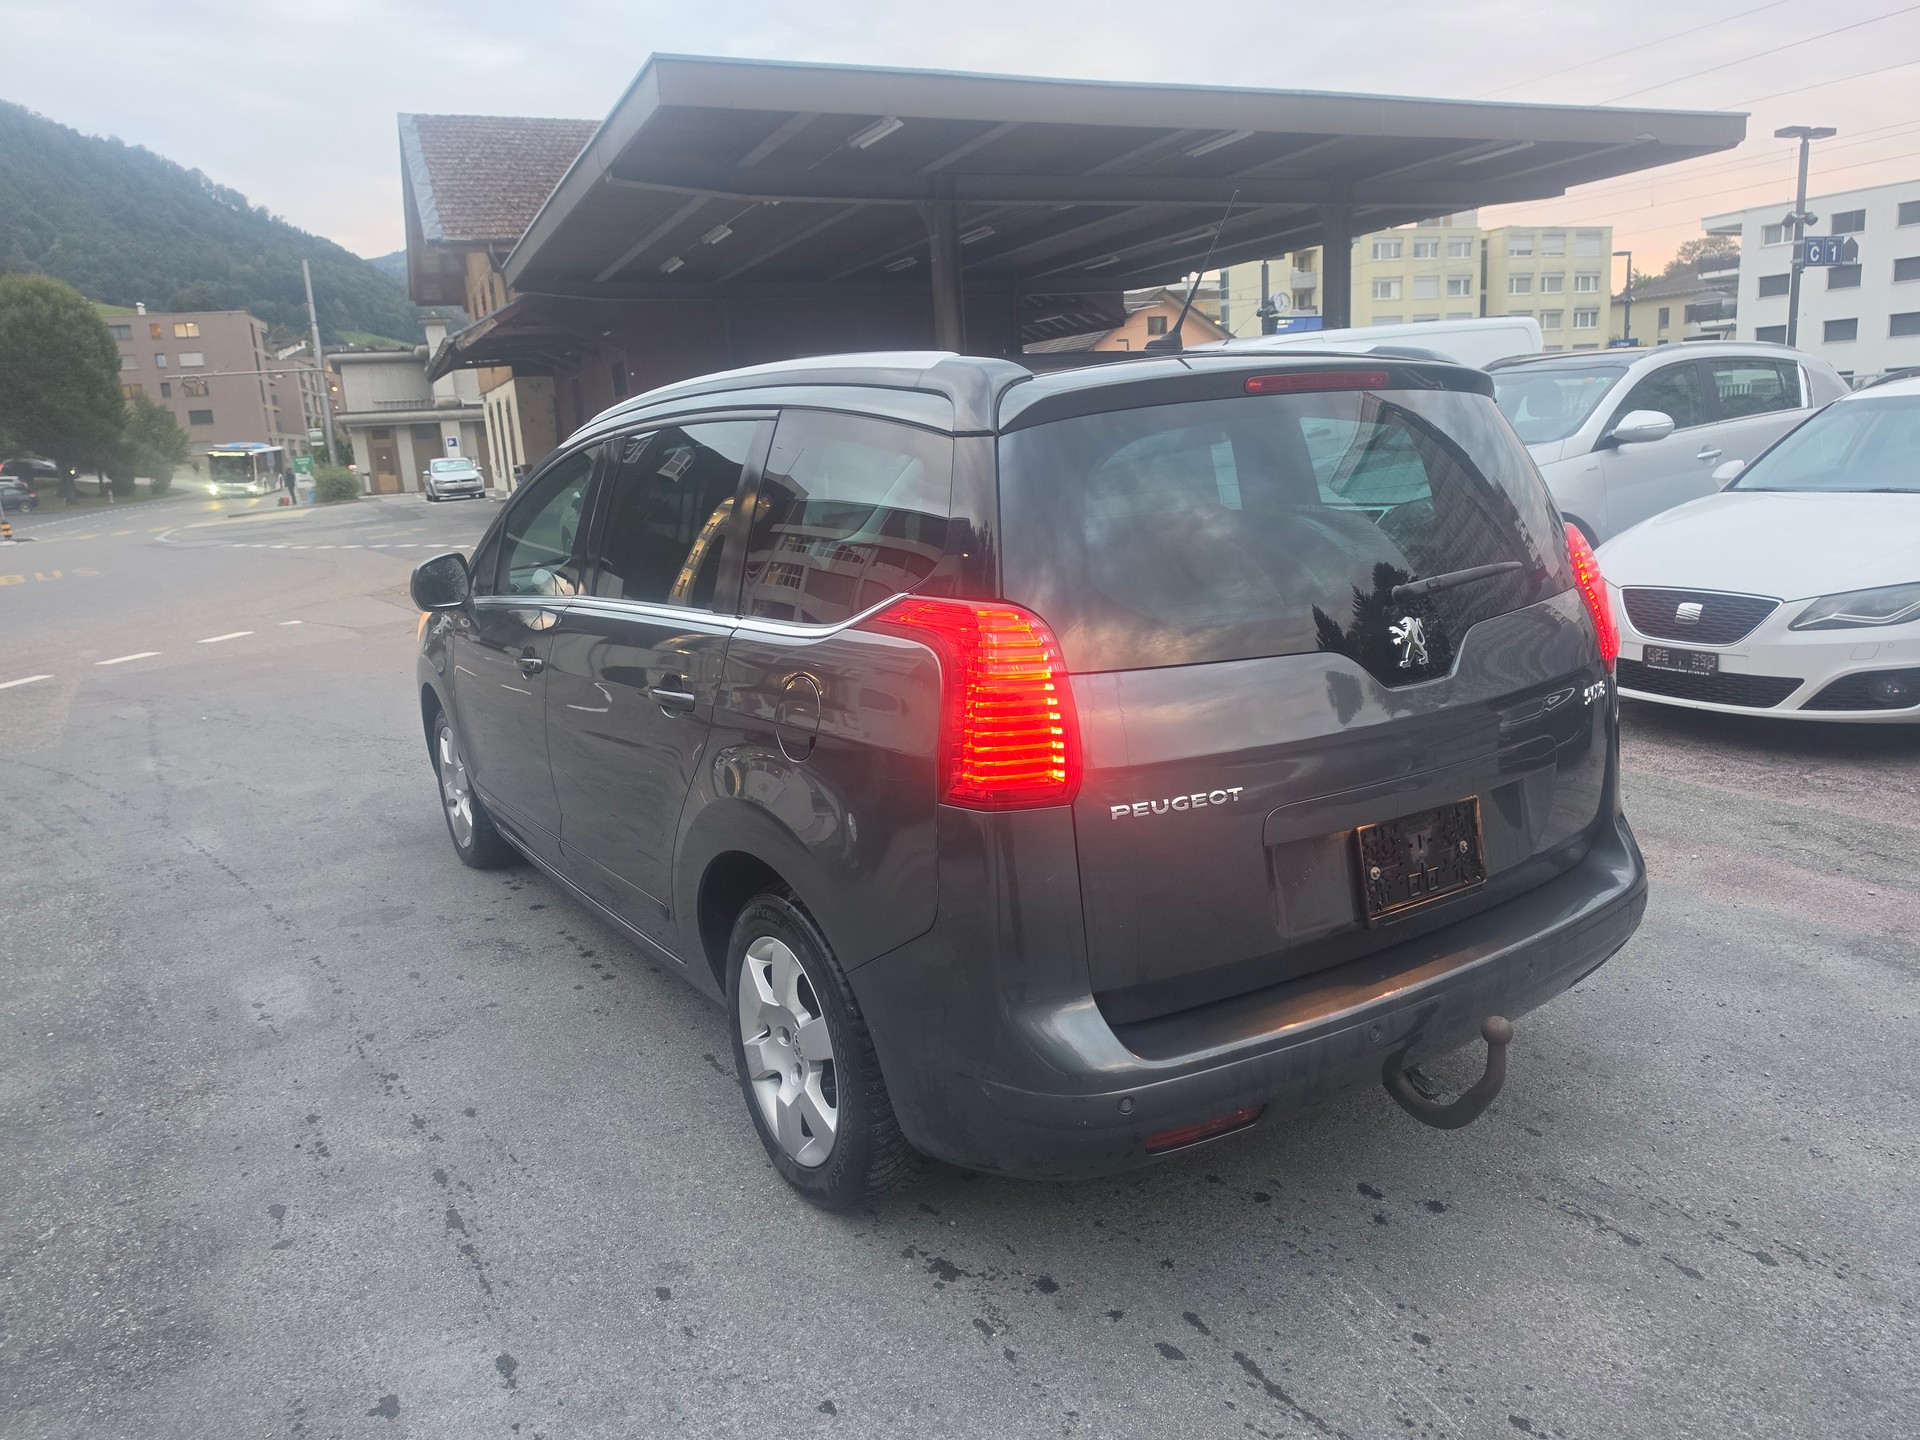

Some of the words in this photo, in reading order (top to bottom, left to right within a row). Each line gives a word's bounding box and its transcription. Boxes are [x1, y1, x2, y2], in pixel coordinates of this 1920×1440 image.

[1810, 246, 1820, 262] C
[1831, 245, 1837, 261] 1
[1110, 786, 1244, 821] PEUGEOT
